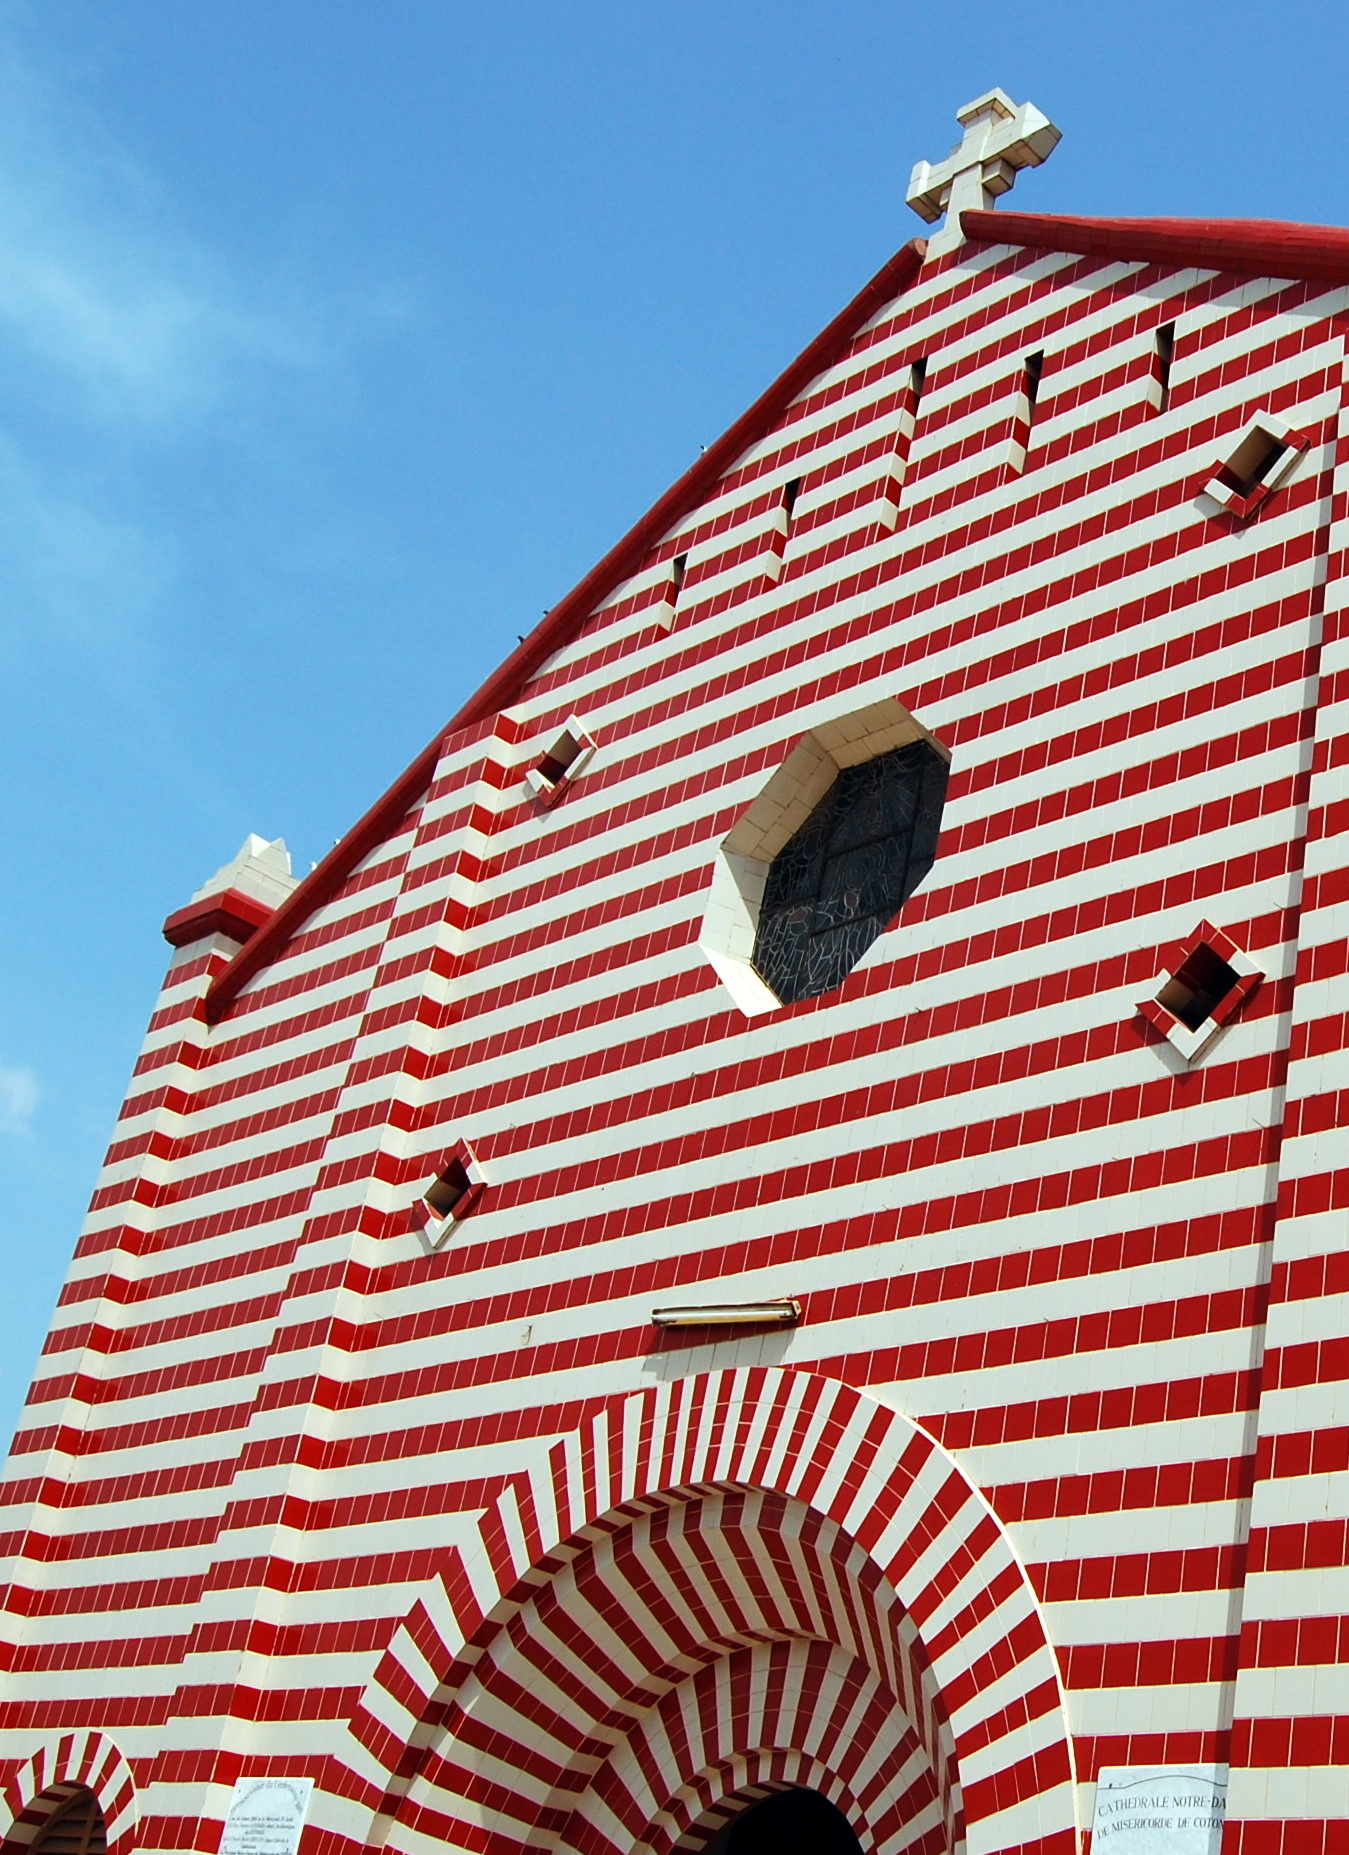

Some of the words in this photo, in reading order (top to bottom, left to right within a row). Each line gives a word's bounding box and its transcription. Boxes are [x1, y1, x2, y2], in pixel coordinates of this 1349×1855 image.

[1098, 1797, 1169, 1817] CATHEDRALE
[1097, 1826, 1109, 1840] DE
[1111, 1818, 1173, 1834] MISERICORDE
[1177, 1818, 1190, 1829] DE
